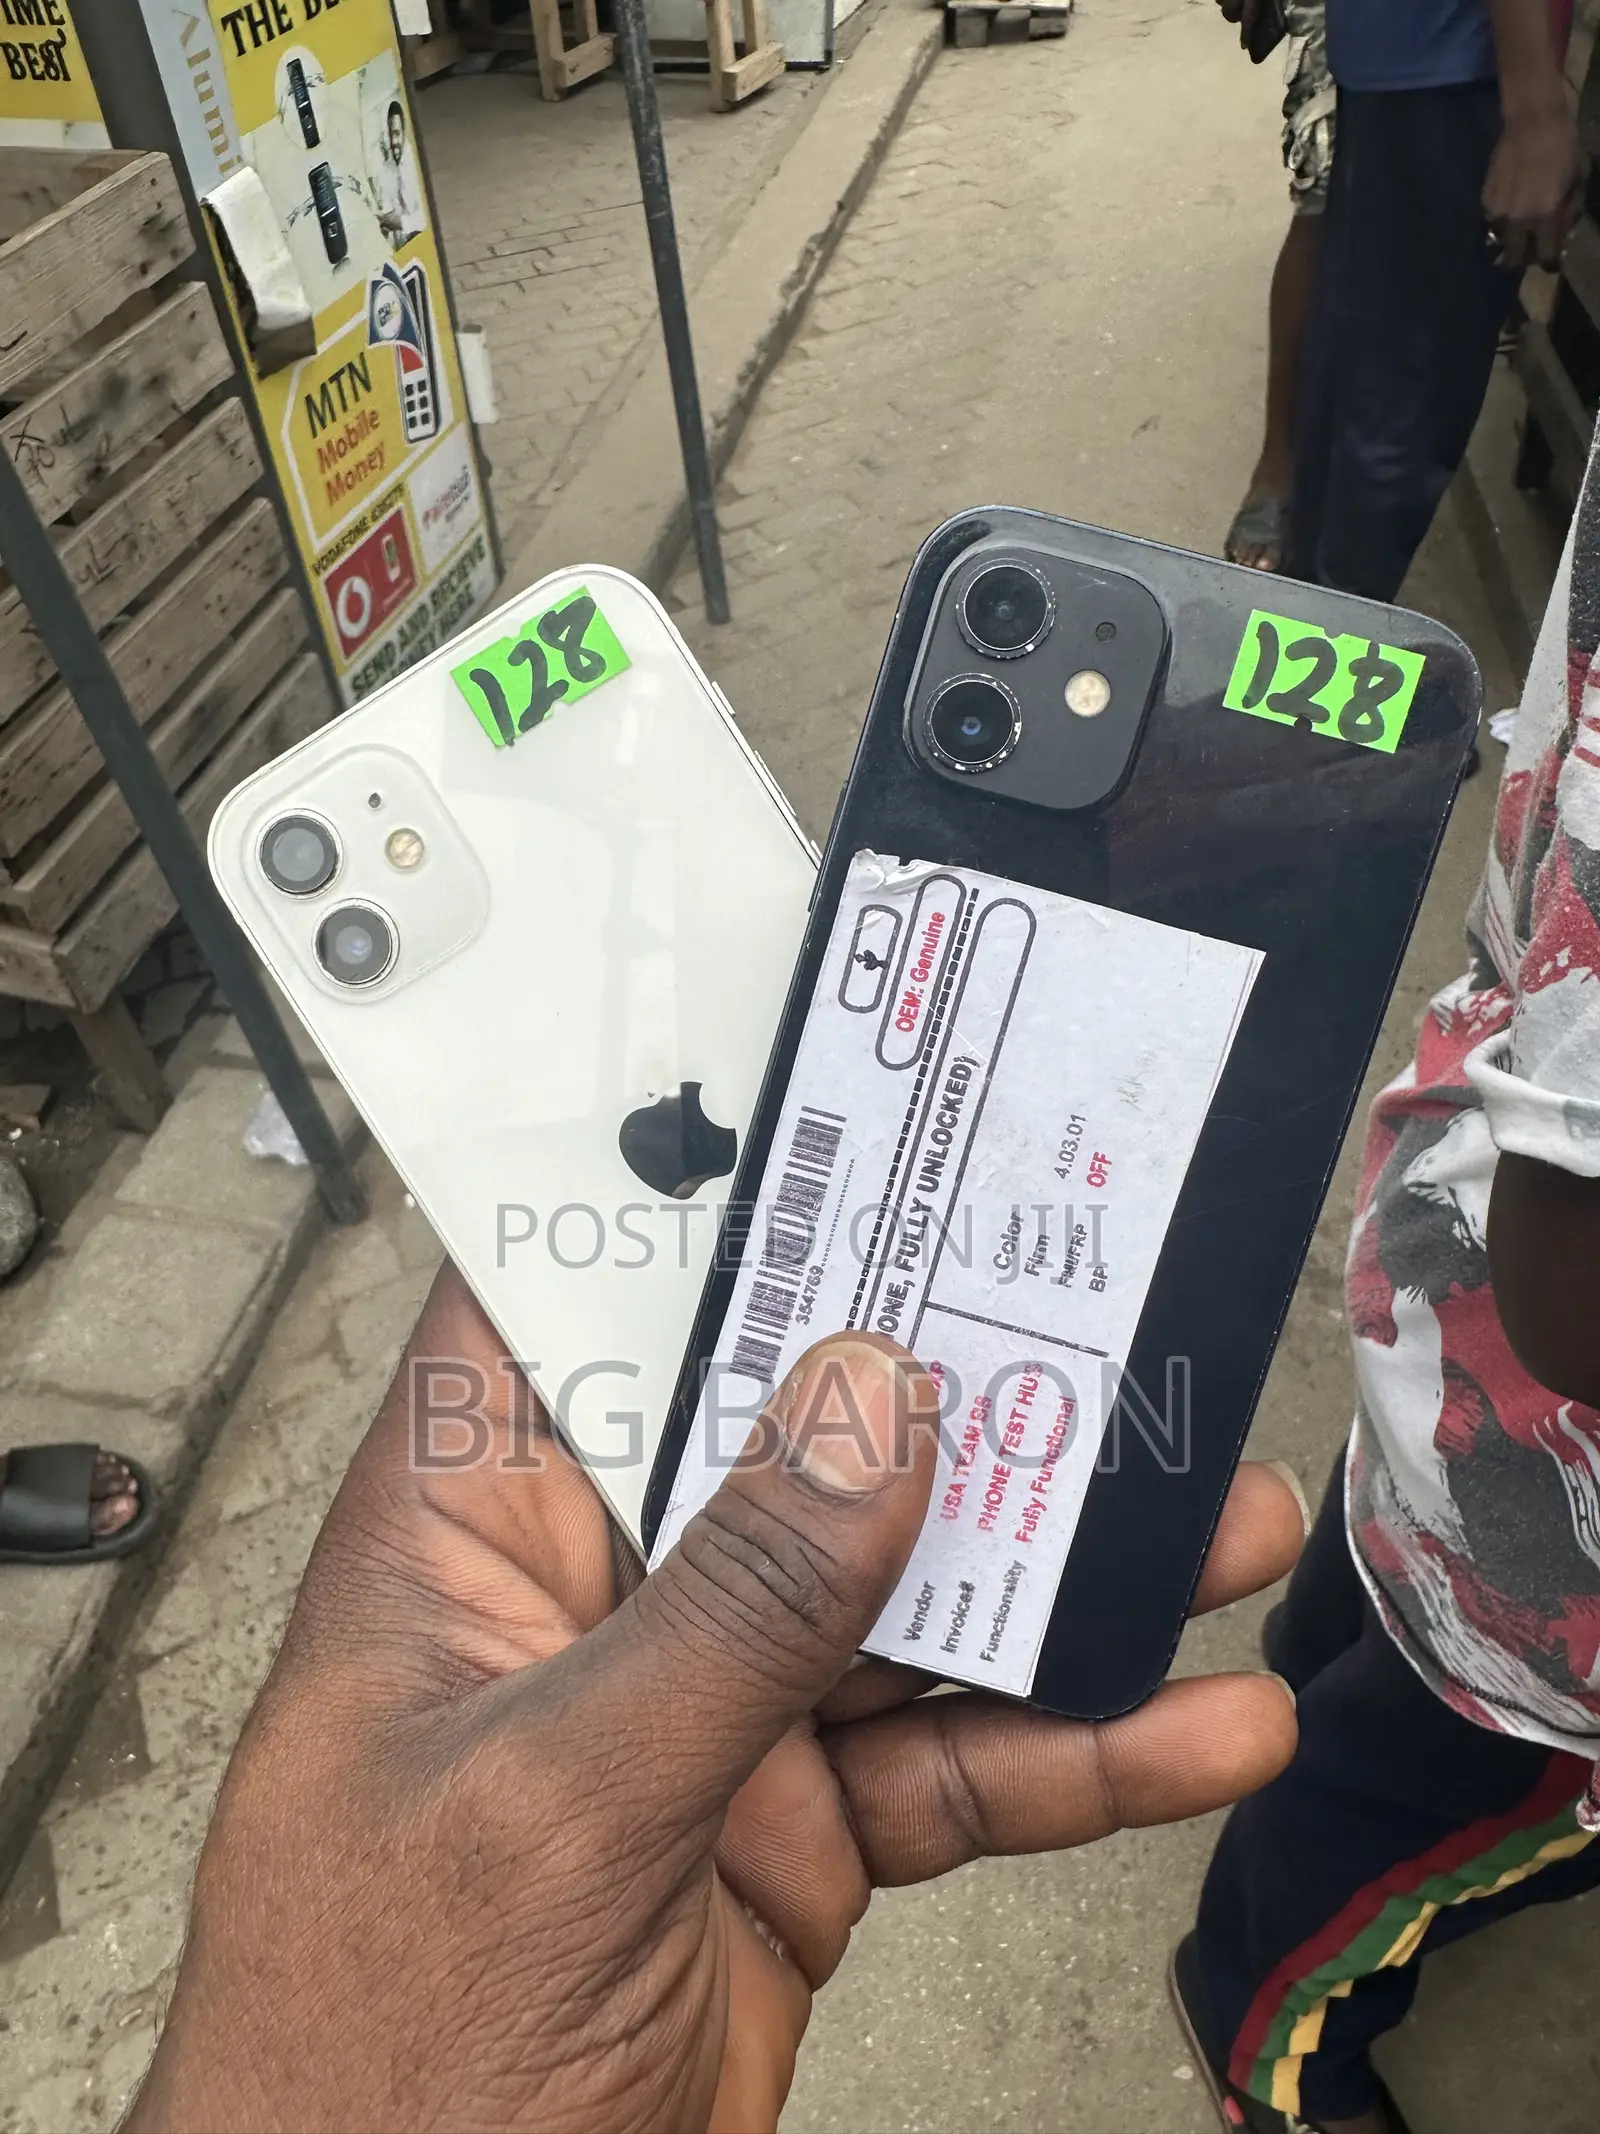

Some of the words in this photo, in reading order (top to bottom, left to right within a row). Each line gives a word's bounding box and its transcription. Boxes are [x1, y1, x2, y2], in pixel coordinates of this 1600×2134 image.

[0, 28, 71, 81] BEST
[221, 0, 294, 57] THE
[305, 352, 372, 439] MTN
[316, 409, 380, 474] Mobile
[325, 440, 386, 508] Money
[469, 596, 607, 747] 128
[1242, 621, 1405, 743] 128
[910, 912, 945, 982] Genuine
[1054, 1114, 1087, 1179] 4.03.01
[1086, 1151, 1112, 1187] OFF
[894, 1197, 931, 1273] FULLY
[993, 1211, 1024, 1269] Color
[1088, 1266, 1108, 1292] BP
[976, 1462, 1012, 1531] PHONE
[998, 1407, 1029, 1457] TEST
[1030, 1396, 1076, 1494] Functional
[1015, 1497, 1047, 1543] Fully
[903, 1580, 935, 1640] Vendor
[980, 1560, 1027, 1662] Functionality
